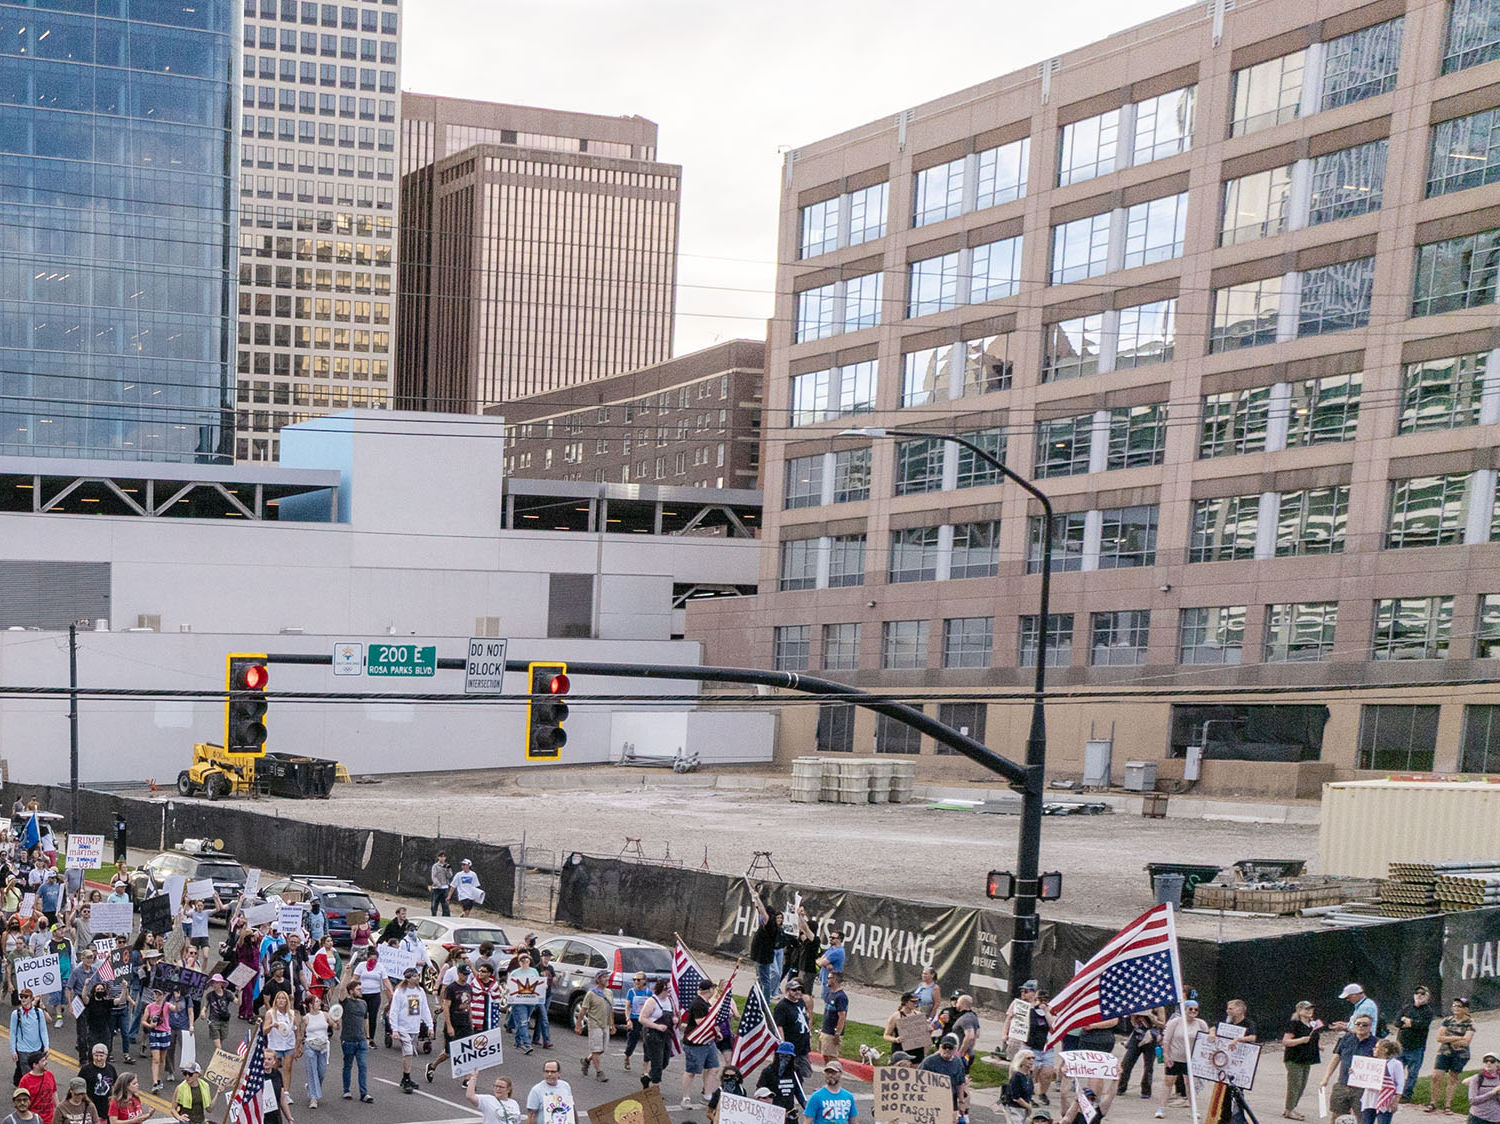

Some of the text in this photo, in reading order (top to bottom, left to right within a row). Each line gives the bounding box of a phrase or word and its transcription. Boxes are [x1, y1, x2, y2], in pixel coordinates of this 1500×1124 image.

[379, 647, 425, 664] 200 E.
[471, 644, 504, 657] DO NOT
[370, 666, 434, 677] ROSA PARKS BLVD.
[469, 663, 501, 676] BLOCK
[468, 680, 500, 689] INTERSECTION
[72, 836, 101, 845] TRUMP
[842, 920, 937, 969] PARKING
[16, 957, 59, 974] ABOLISH
[23, 977, 40, 988] ICE
[453, 1043, 501, 1066] KINGS!
[1086, 1051, 1104, 1062] NO
[881, 1067, 952, 1091] NO KINGS
[882, 1083, 928, 1094] NO ICE
[822, 1099, 852, 1109] HANDS
[882, 1093, 926, 1103] NO KKK
[882, 1103, 941, 1118] NO FASCIST
